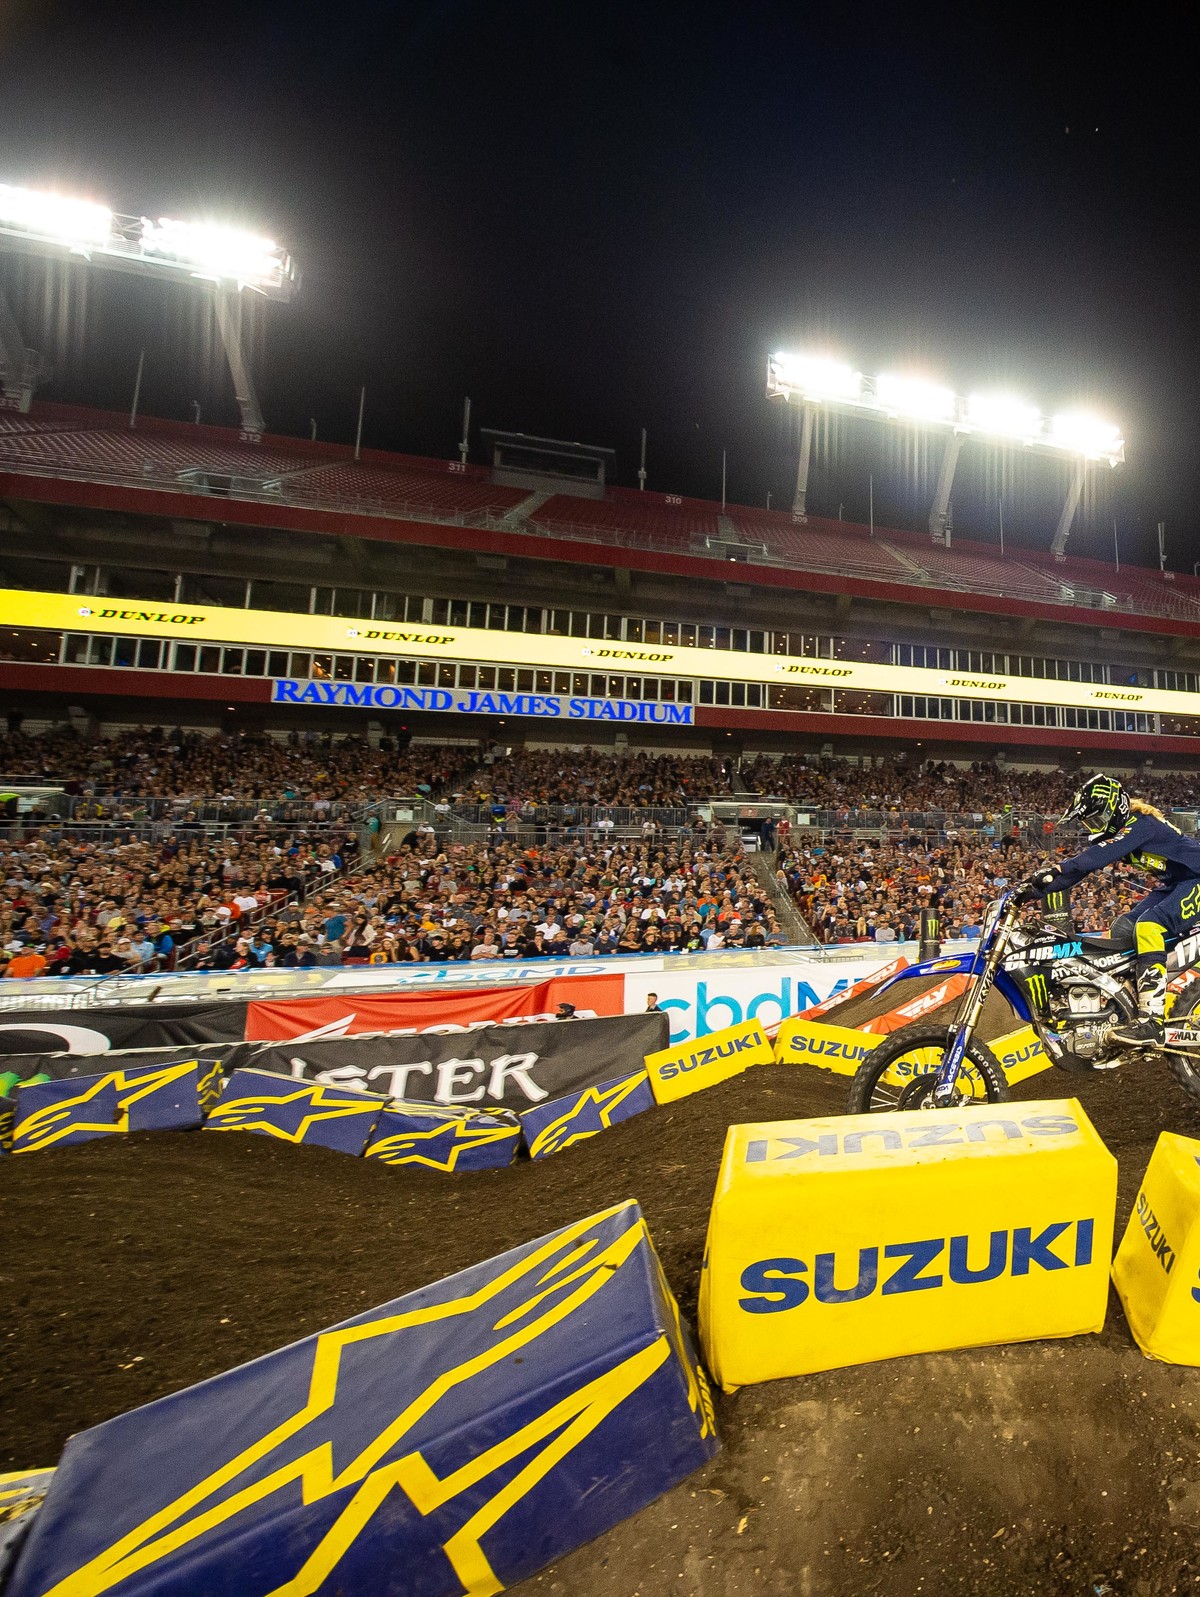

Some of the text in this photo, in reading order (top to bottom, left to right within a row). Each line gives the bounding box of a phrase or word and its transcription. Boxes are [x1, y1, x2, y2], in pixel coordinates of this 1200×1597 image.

[665, 496, 682, 505] 310
[98, 609, 207, 625] DUNLOP
[363, 630, 456, 645] DUNLOP
[596, 648, 674, 662] DUNLOP
[787, 665, 853, 677] DUNLOP
[949, 679, 1007, 690] DUNLOP
[273, 678, 694, 725] RAYMOND JAMES STADIUM
[1094, 691, 1144, 702] DUNLOP
[896, 984, 948, 1017] FLY
[1168, 1030, 1198, 1042] ZMAX
[659, 1031, 763, 1081] SUZUKI
[790, 1034, 874, 1062] SUZUK
[1001, 1040, 1044, 1069] SUZ
[745, 1114, 1079, 1164] SUZUKI
[1137, 1192, 1176, 1274] SUZUKI
[738, 1217, 1095, 1314] SUZUKI
